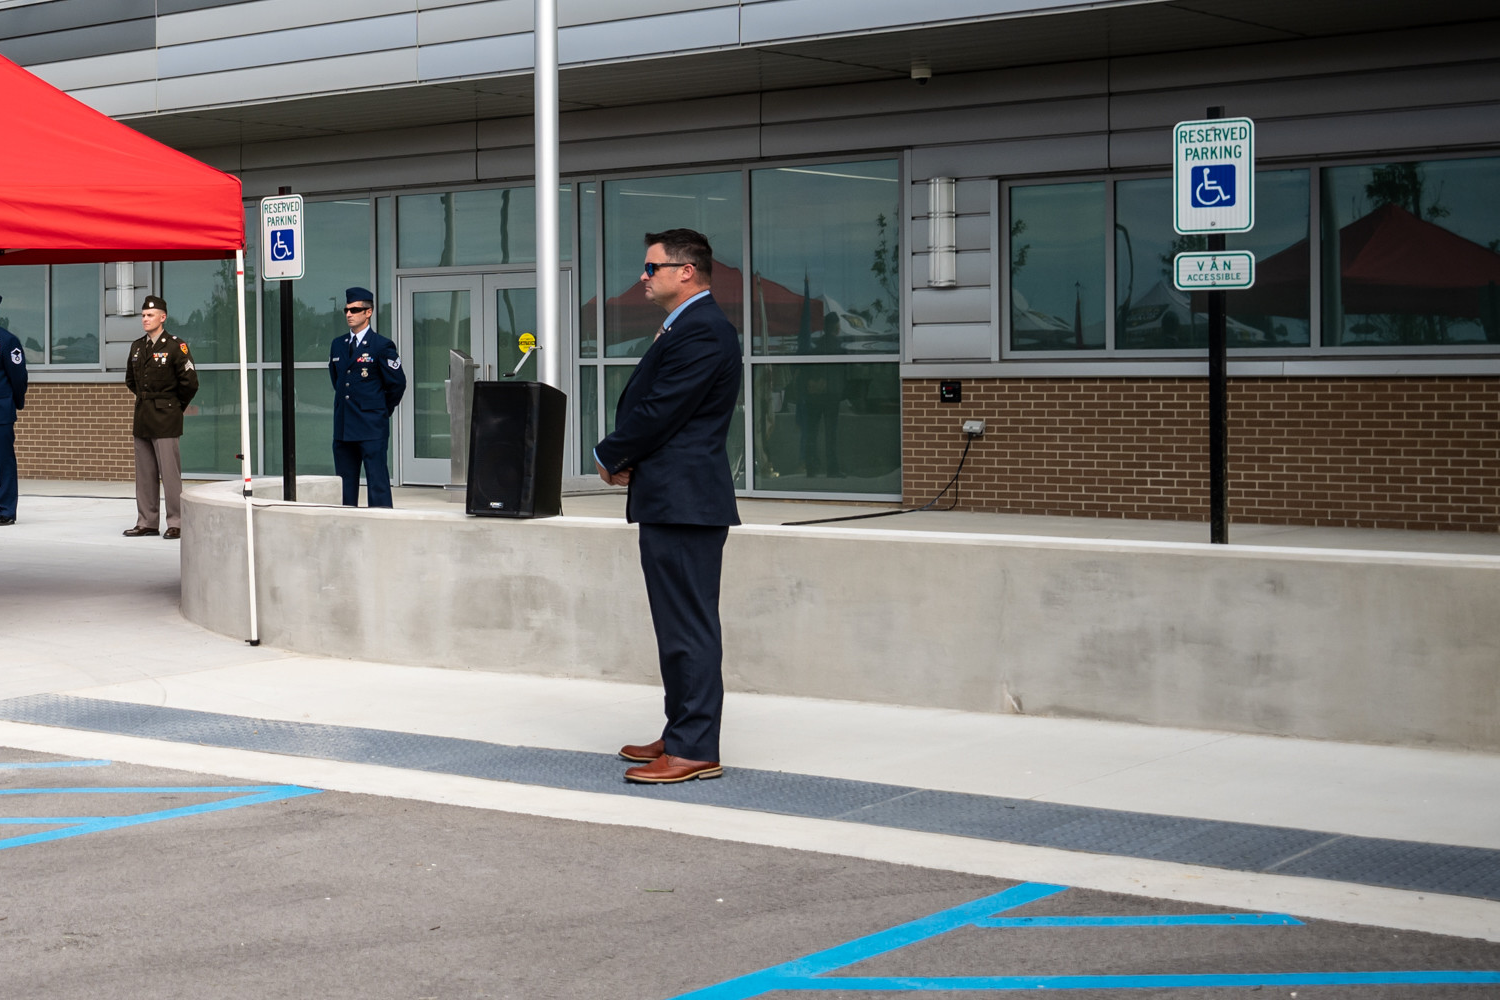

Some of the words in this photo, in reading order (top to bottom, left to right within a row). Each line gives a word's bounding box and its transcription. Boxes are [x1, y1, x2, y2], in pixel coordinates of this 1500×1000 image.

[1180, 127, 1247, 144] RESERVED
[1185, 145, 1242, 161] PARKING
[264, 201, 299, 214] RESERVED
[267, 215, 297, 227] PARKING
[1197, 260, 1231, 271] VAN
[1187, 273, 1241, 281] ACCESSIBLE
